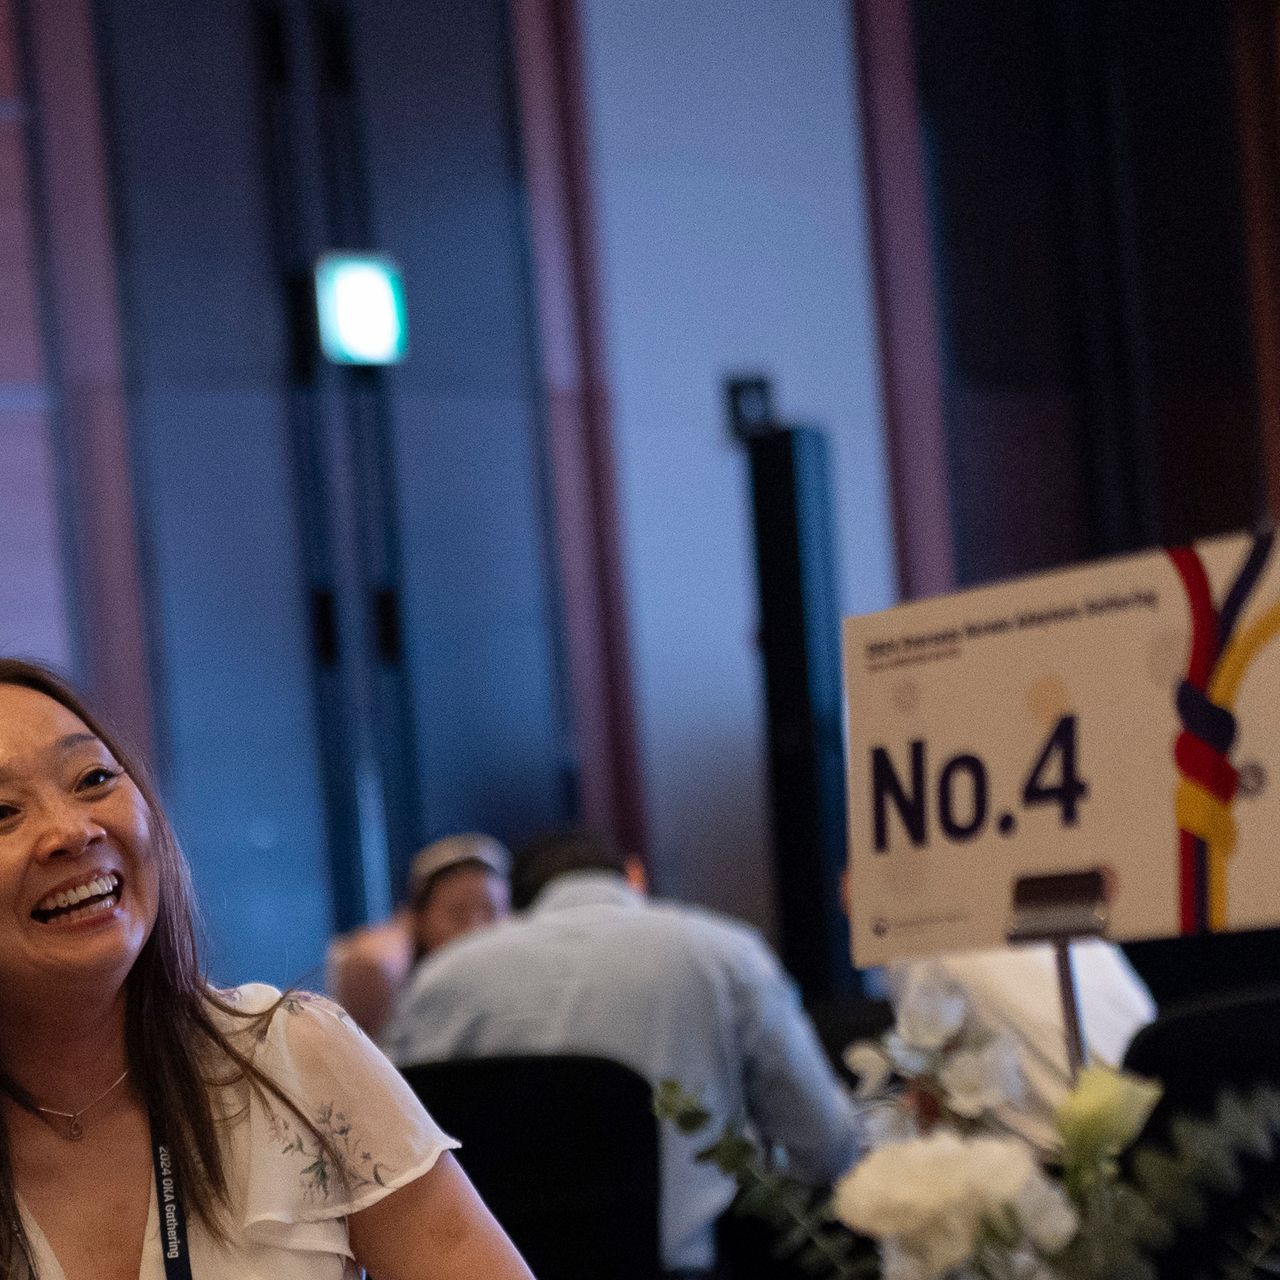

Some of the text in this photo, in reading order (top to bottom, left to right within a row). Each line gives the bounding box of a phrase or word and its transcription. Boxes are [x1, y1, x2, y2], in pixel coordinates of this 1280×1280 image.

[872, 715, 1087, 852] No.4
[162, 1178, 175, 1202] OKA
[165, 1204, 180, 1259] Gathering
